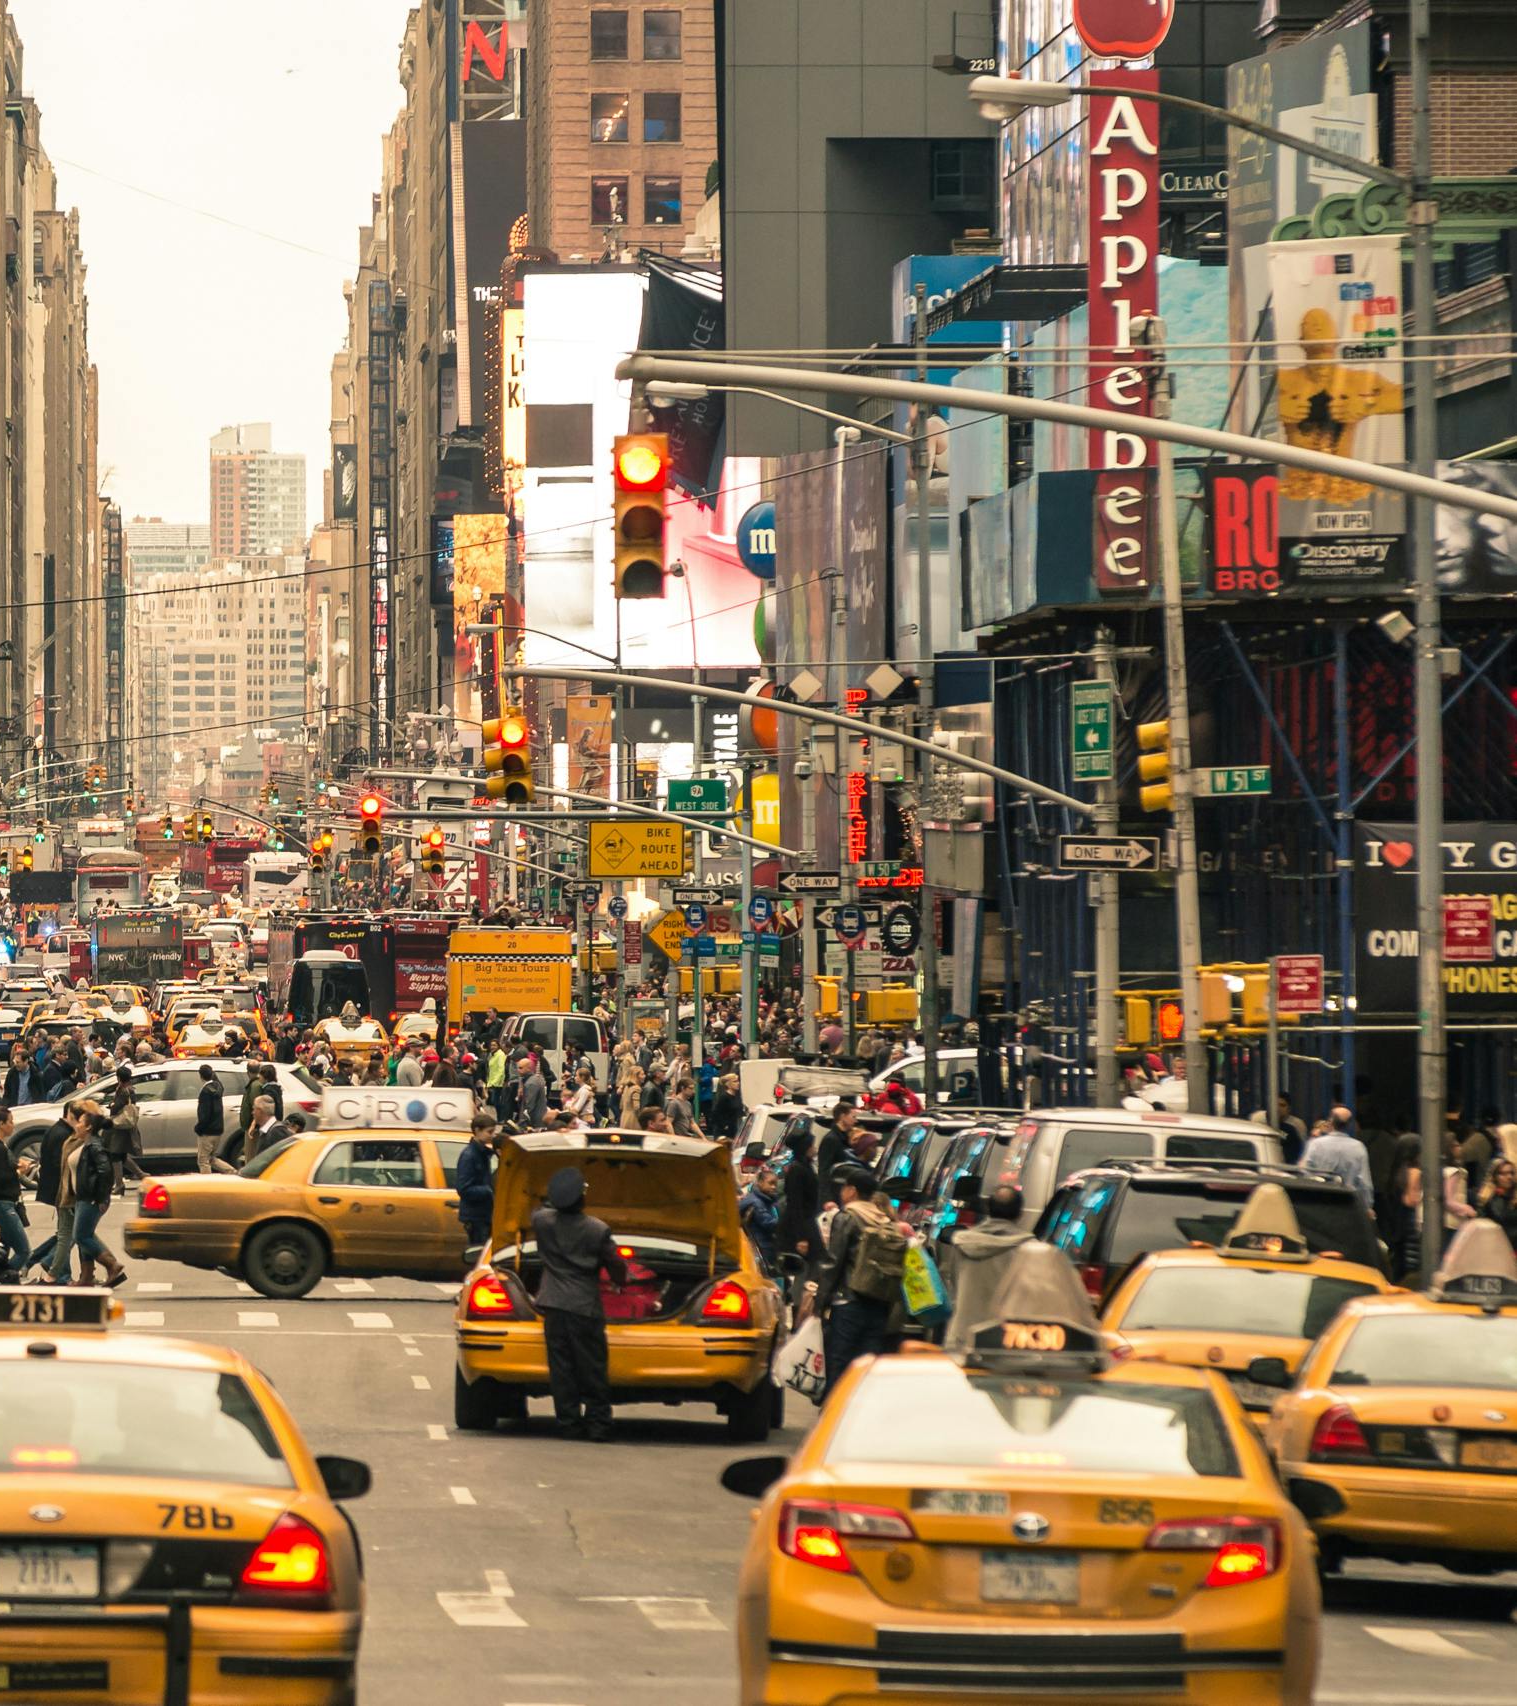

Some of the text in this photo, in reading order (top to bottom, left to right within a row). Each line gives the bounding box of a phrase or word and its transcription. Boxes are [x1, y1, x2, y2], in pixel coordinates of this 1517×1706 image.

[464, 21, 507, 81] N
[969, 58, 995, 71] 2219
[1316, 513, 1370, 529] NOW OPEN
[749, 529, 776, 554] m
[1213, 770, 1266, 791] W 51 ST
[675, 802, 719, 810] WEST SIDE
[755, 800, 779, 825] m
[647, 828, 671, 838] BIKE
[641, 845, 676, 854] ROUTE
[1073, 847, 1143, 860] ONE WAY
[640, 861, 678, 870] AHEAD
[867, 862, 876, 876] W
[879, 862, 890, 876] 50
[789, 876, 836, 887] ONE WAY
[679, 893, 717, 901] ONE WAY
[369, 924, 382, 932] 802
[152, 952, 182, 962] friendly
[474, 963, 550, 974] Big Taxi Tours
[10, 1294, 65, 1322] 2T31
[158, 1504, 234, 1531] 786
